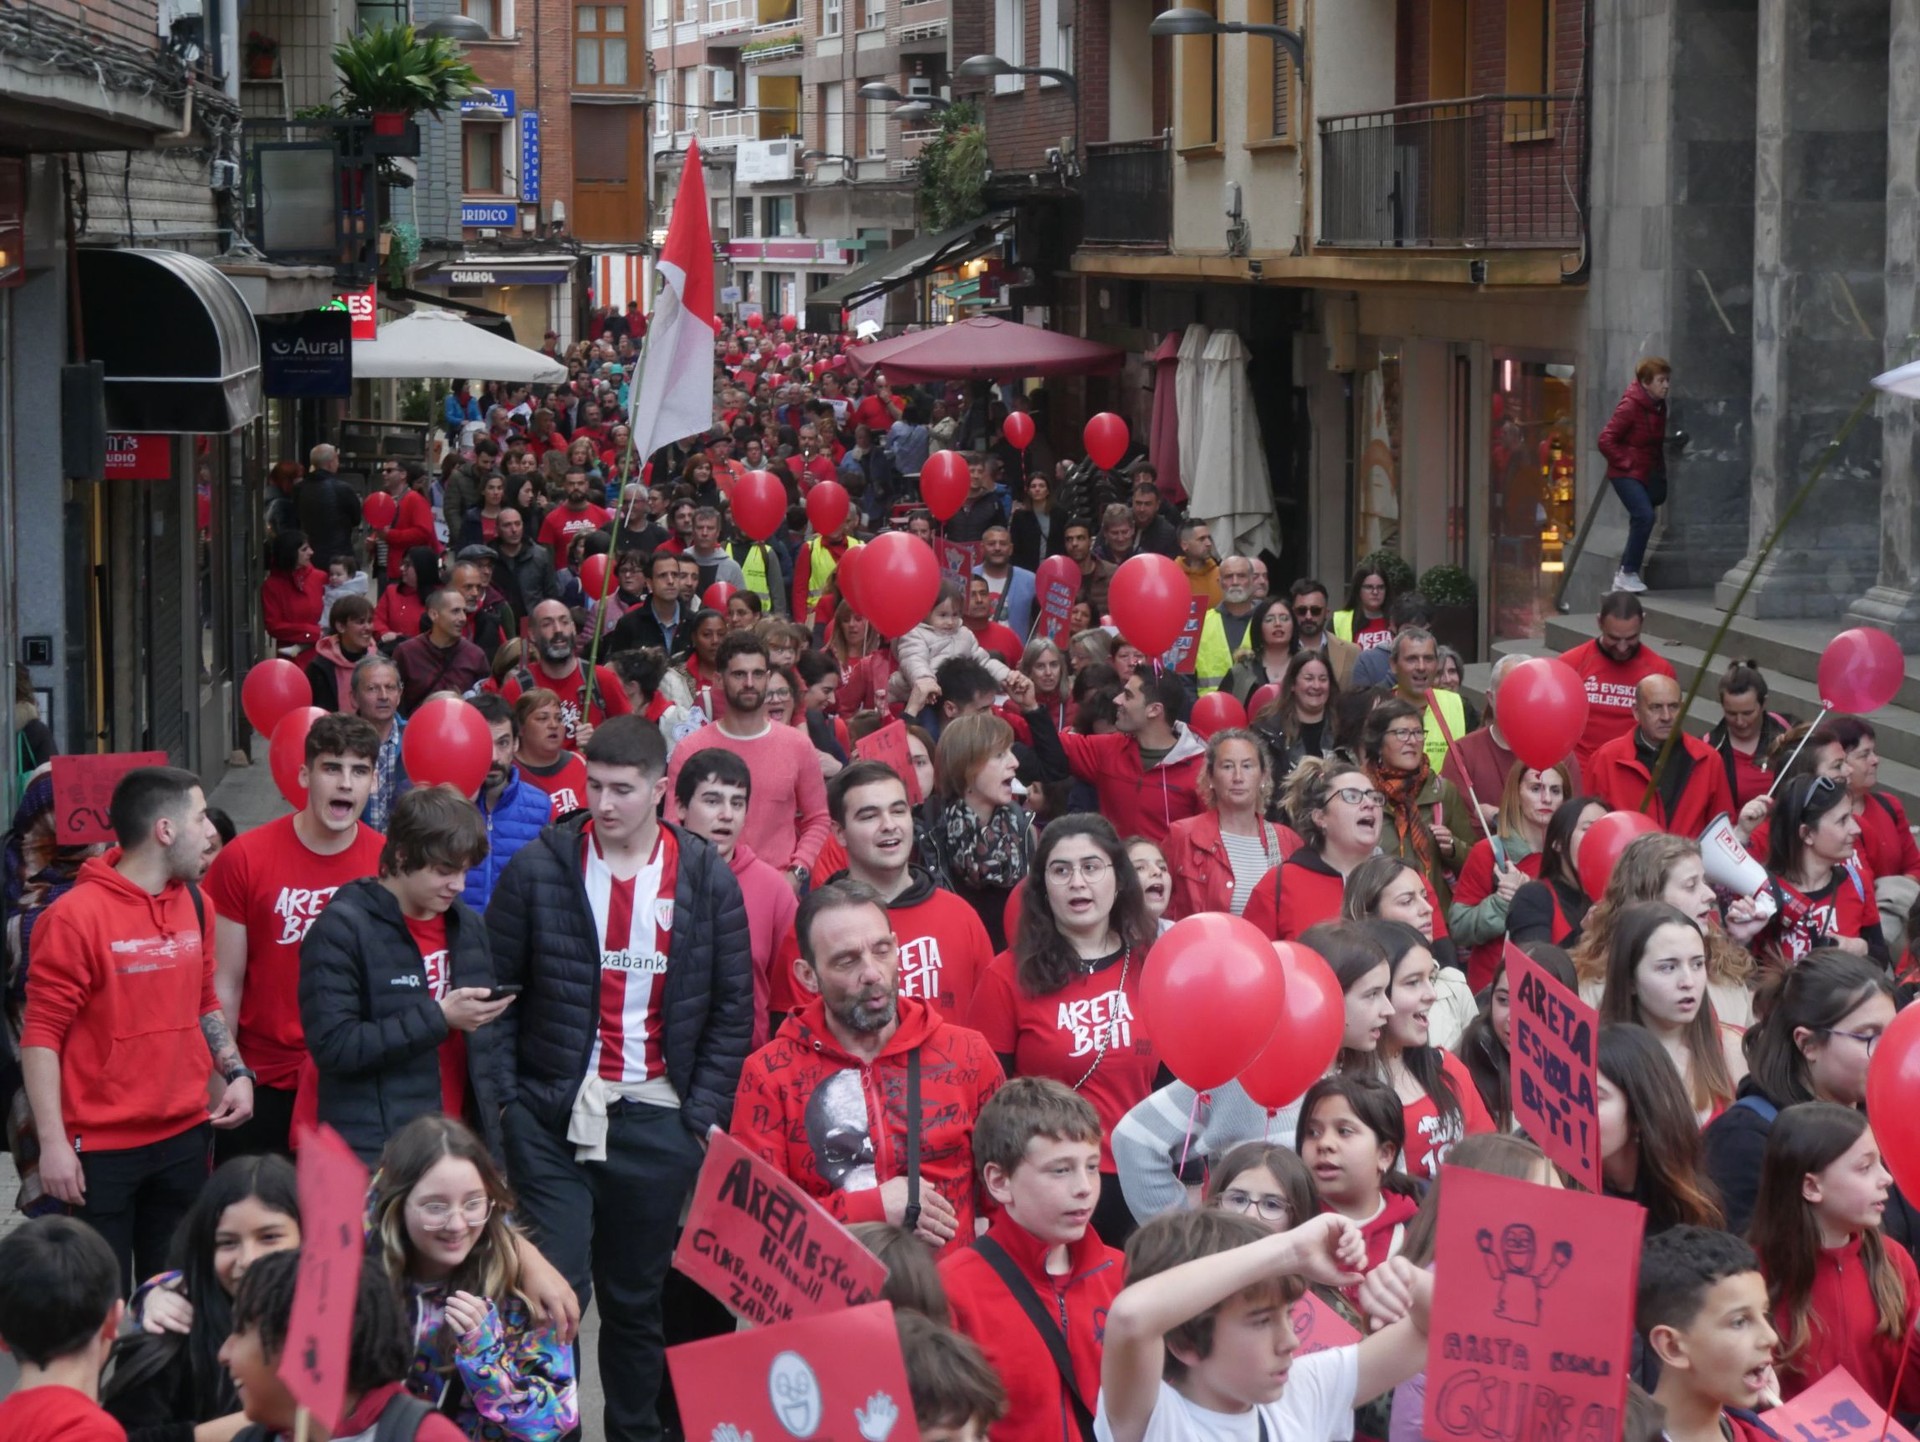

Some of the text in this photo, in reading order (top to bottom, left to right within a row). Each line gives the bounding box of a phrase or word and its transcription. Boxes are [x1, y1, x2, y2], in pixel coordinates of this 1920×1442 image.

[531, 121, 539, 200] LABORAL
[451, 271, 496, 283] CHAROL
[293, 337, 344, 355] Aural
[1057, 990, 1134, 1031] ARETA
[1517, 970, 1591, 1067] ARETA
[1068, 1018, 1131, 1057] BETI
[717, 1158, 807, 1261] ARETA
